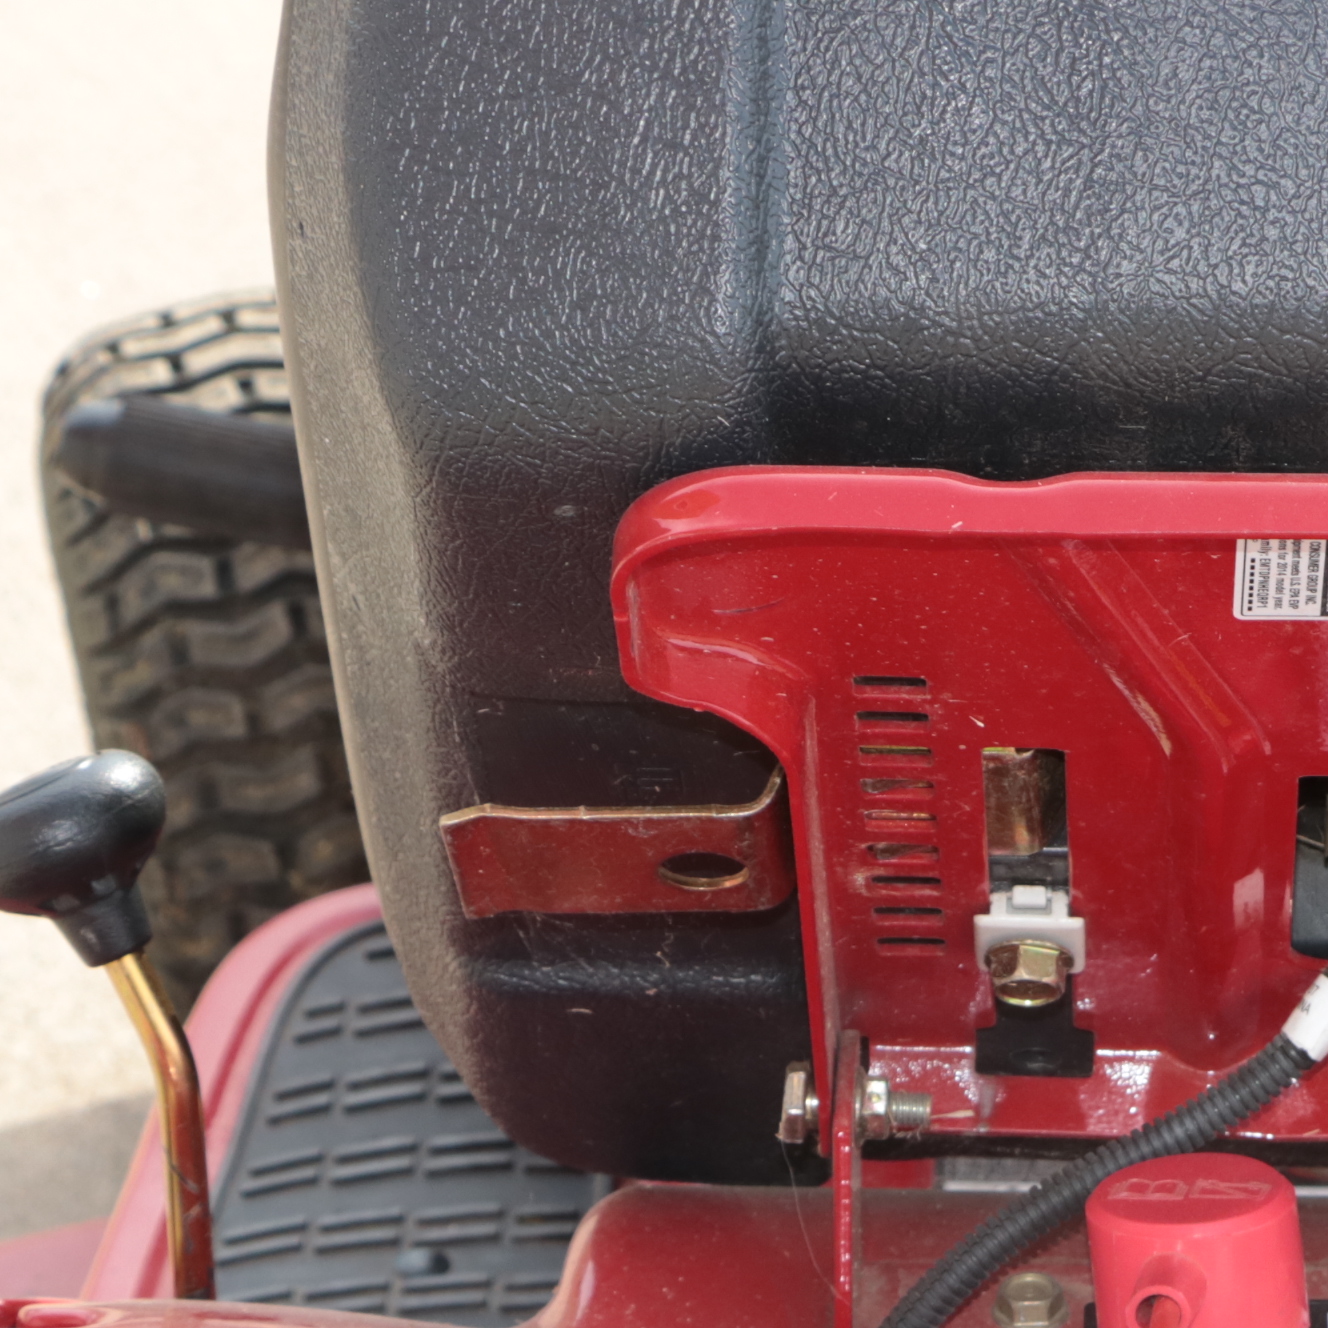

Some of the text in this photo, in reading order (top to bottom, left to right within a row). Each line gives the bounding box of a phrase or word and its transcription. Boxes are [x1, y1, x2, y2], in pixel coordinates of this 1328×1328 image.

[1258, 539, 1271, 556] mily:
[1278, 552, 1288, 560] for
[1277, 562, 1288, 576] 2014
[1305, 542, 1321, 605] CONSUMER GROUP INC.
[1275, 578, 1285, 595] model
[1273, 597, 1284, 610] year.
